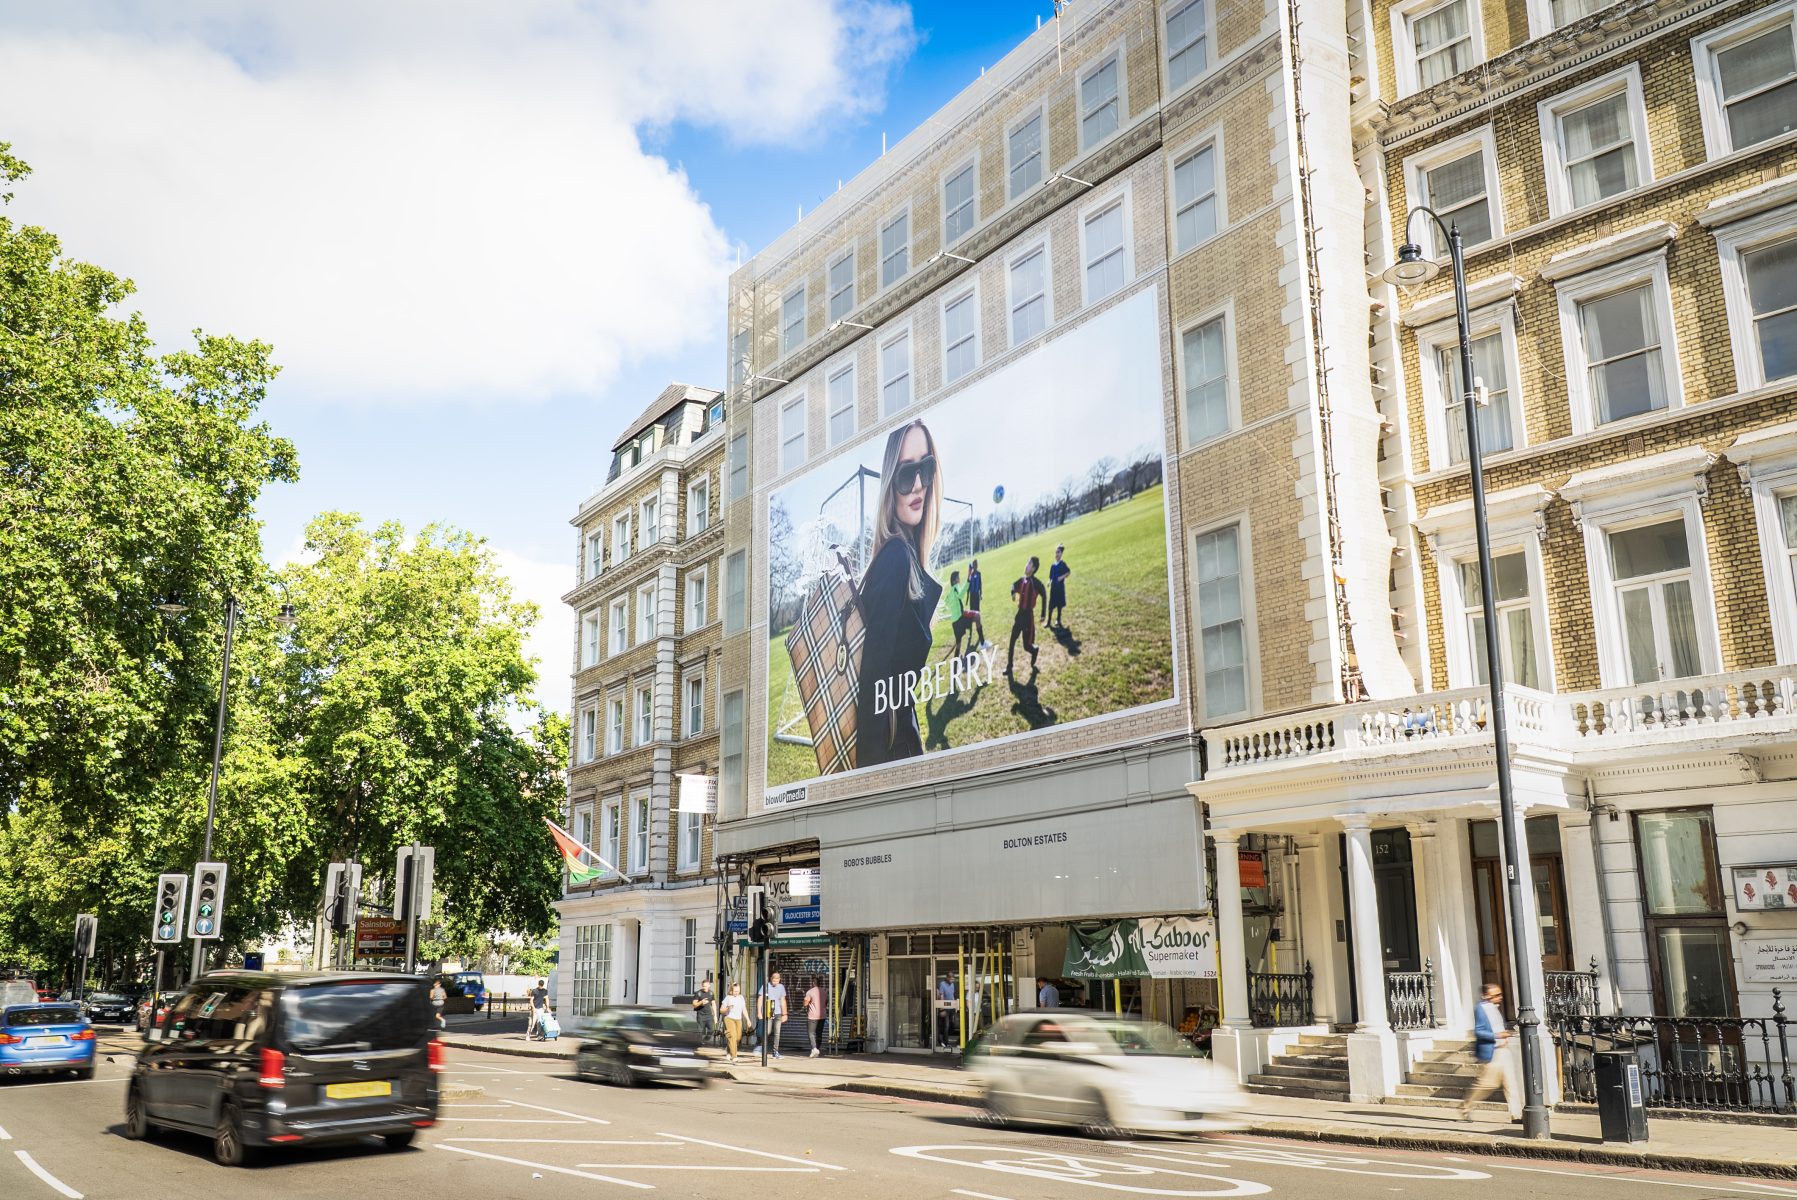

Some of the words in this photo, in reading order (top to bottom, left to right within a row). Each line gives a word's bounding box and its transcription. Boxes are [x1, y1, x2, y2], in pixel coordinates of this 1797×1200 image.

[874, 644, 999, 715] BURBERRY
[1003, 836, 1033, 849] BOLTON
[1034, 832, 1068, 845] ESTATES
[1376, 844, 1389, 854] 152
[843, 857, 865, 868] BOBO'S
[865, 854, 892, 865] BUBBLES
[784, 911, 811, 920] GLOUCESTER
[360, 920, 397, 930] Sainsbury
[1148, 950, 1199, 963] Supermaket
